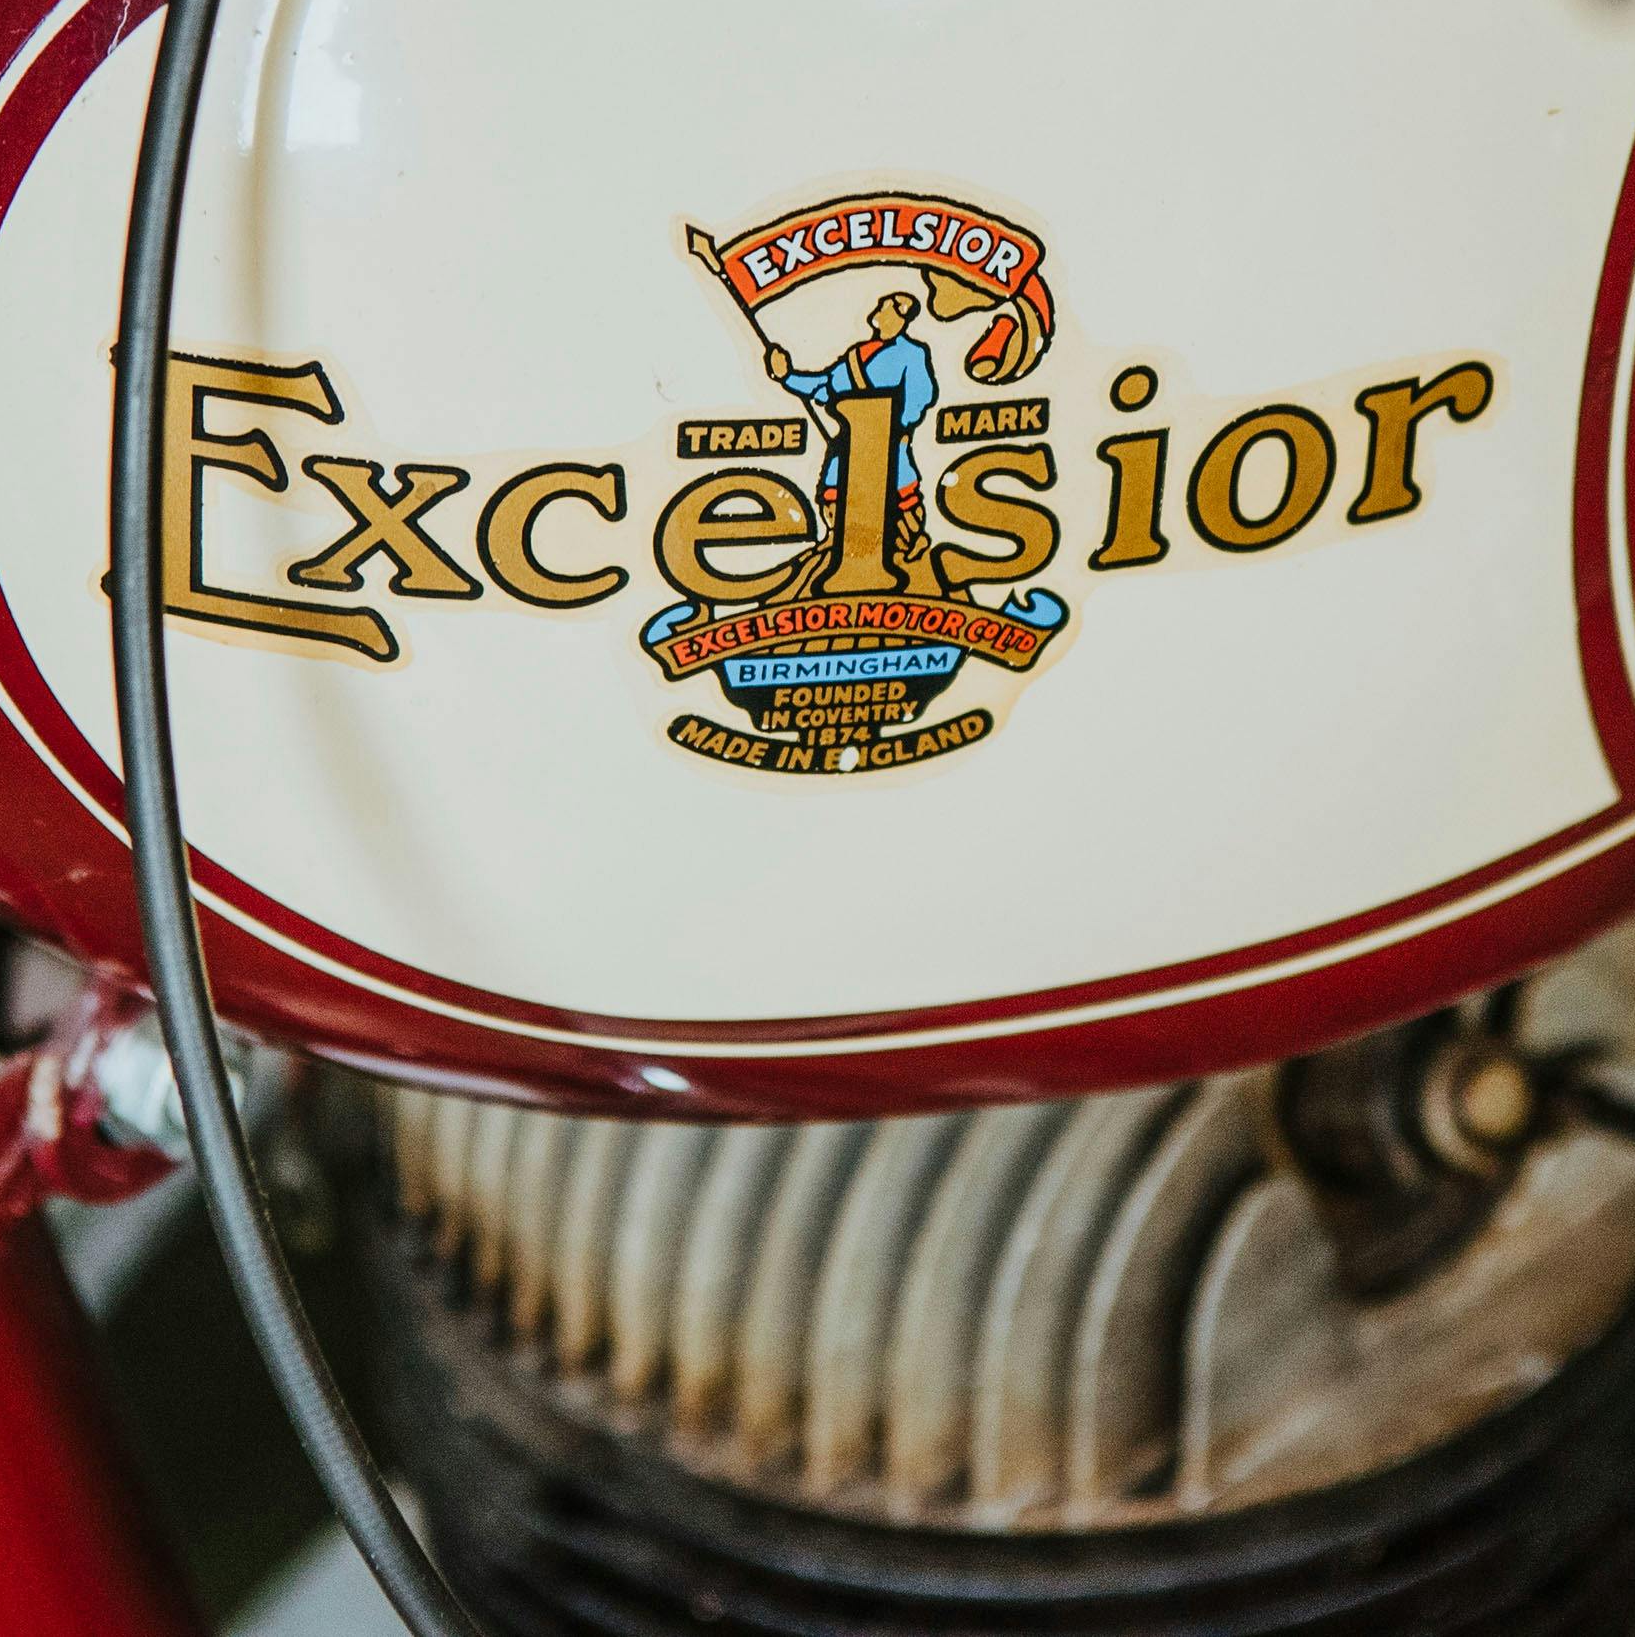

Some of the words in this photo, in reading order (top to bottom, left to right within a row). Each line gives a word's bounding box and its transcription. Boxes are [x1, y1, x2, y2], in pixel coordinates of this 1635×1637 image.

[742, 210, 1023, 289] EXCELSIOR
[684, 423, 803, 454] TRADE
[942, 403, 1044, 439] MARK
[100, 348, 1495, 663] Excelsior
[671, 602, 852, 667] EXCELSIOR
[857, 602, 966, 638] MOTOR
[738, 651, 949, 683] BIRMINGHAM
[761, 710, 790, 731] IN
[795, 700, 918, 728] COVENTRY
[773, 681, 907, 708] FOUNDED
[677, 718, 766, 767] MADE
[775, 747, 814, 771] IN
[807, 725, 872, 747] 1874
